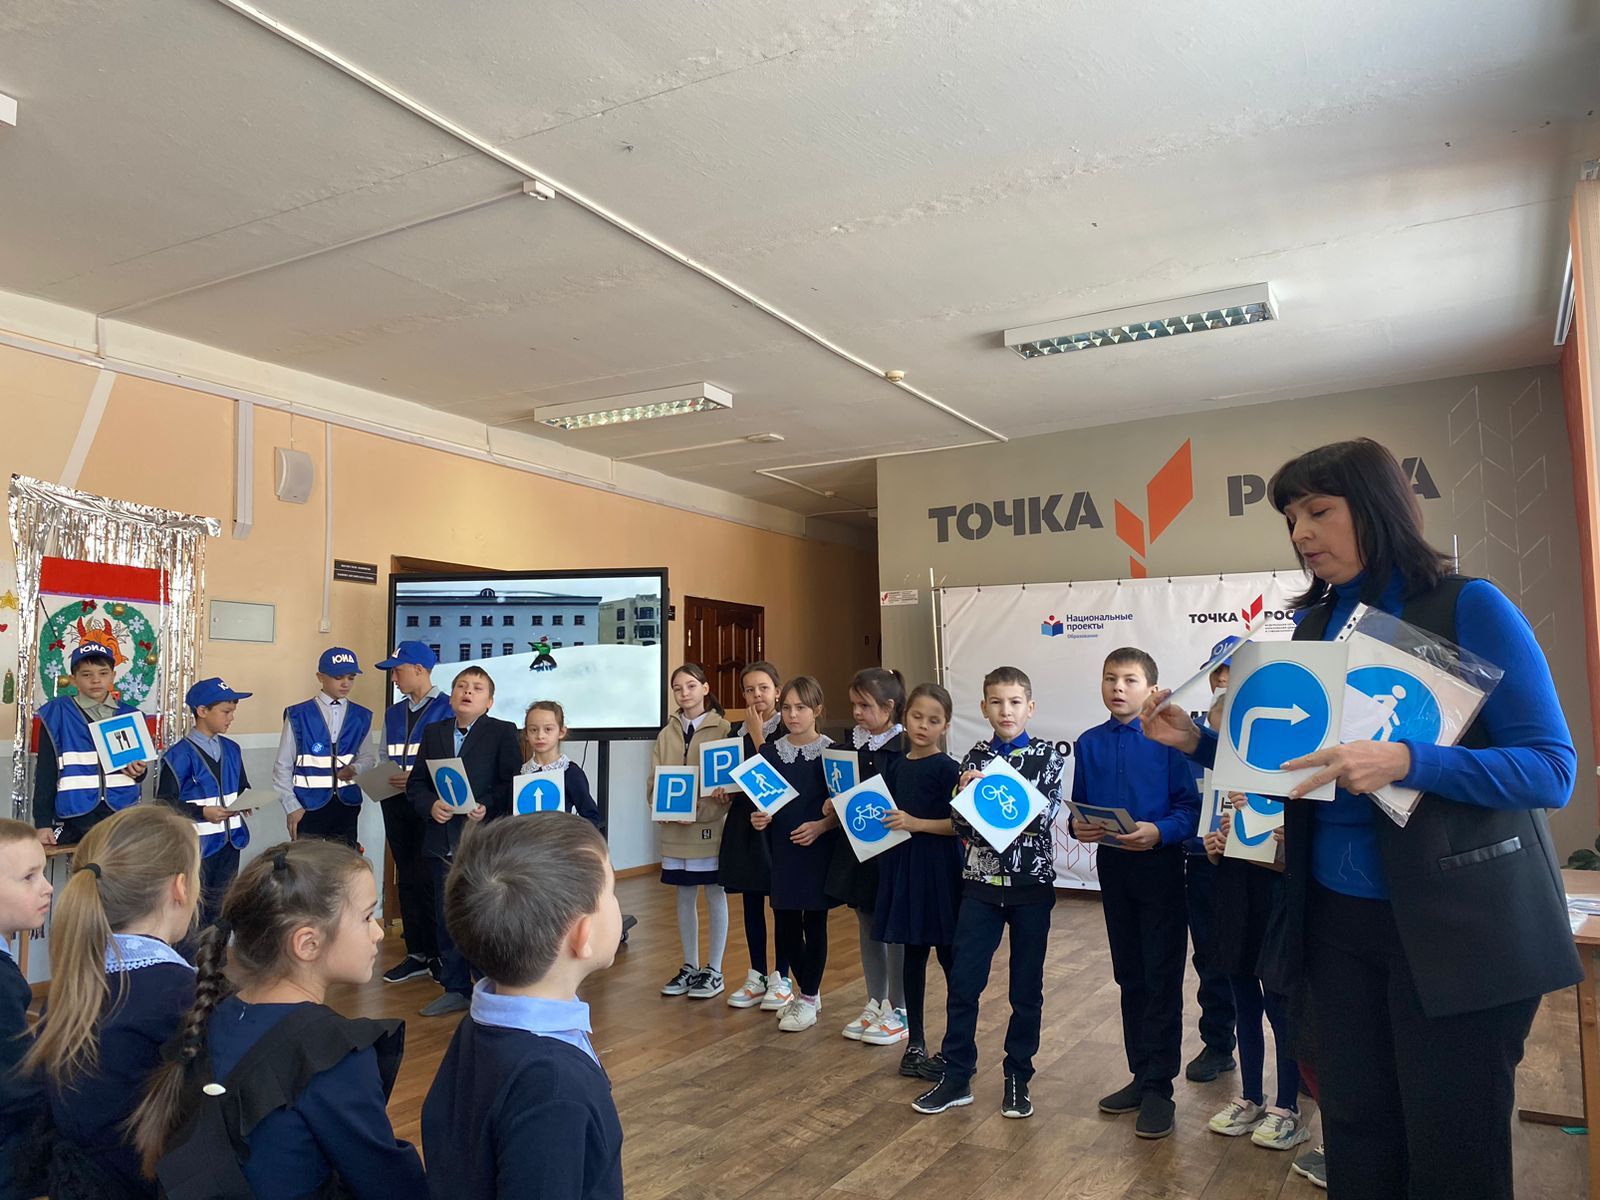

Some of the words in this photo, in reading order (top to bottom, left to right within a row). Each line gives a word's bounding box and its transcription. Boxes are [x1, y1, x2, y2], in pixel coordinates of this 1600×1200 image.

[928, 491, 1104, 543] ТОЧКА
[1066, 613, 1133, 623] Национальные
[1066, 622, 1104, 631] проекты
[1188, 612, 1239, 623] ТОЧКА
[1264, 609, 1296, 620] РОС
[713, 750, 733, 783] P
[666, 777, 687, 810] P
